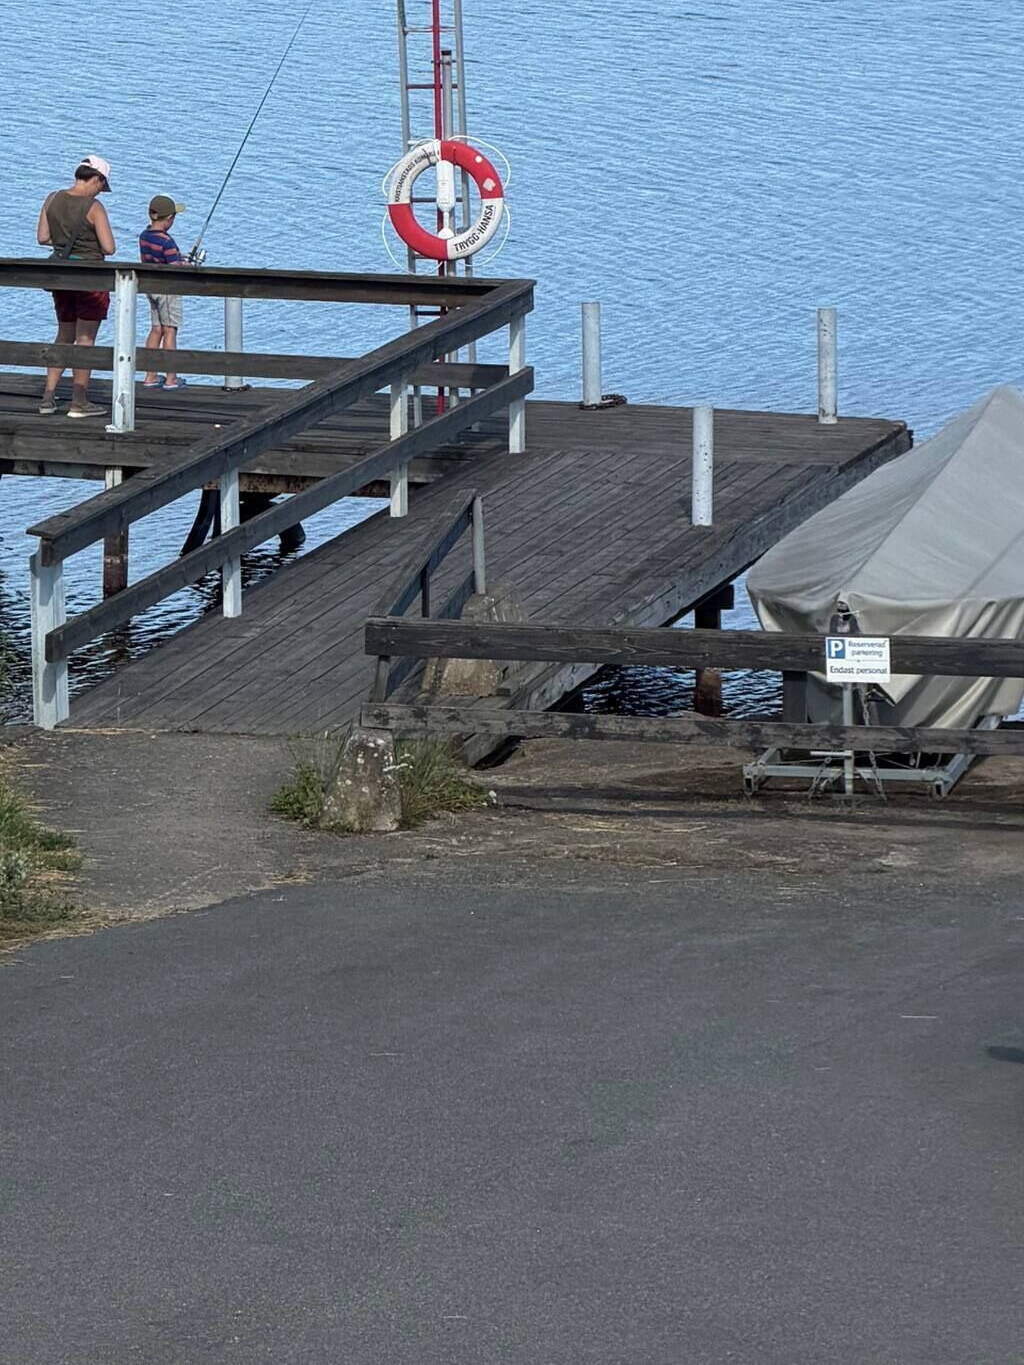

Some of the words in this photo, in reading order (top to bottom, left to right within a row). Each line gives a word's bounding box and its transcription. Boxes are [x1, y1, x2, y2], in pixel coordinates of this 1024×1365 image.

[453, 204, 494, 252] TRYGG-HANSA
[831, 640, 844, 657] P
[848, 640, 887, 648] Reserverad
[851, 650, 883, 658] parkering
[830, 666, 855, 674] Endast
[856, 666, 888, 675] personal
